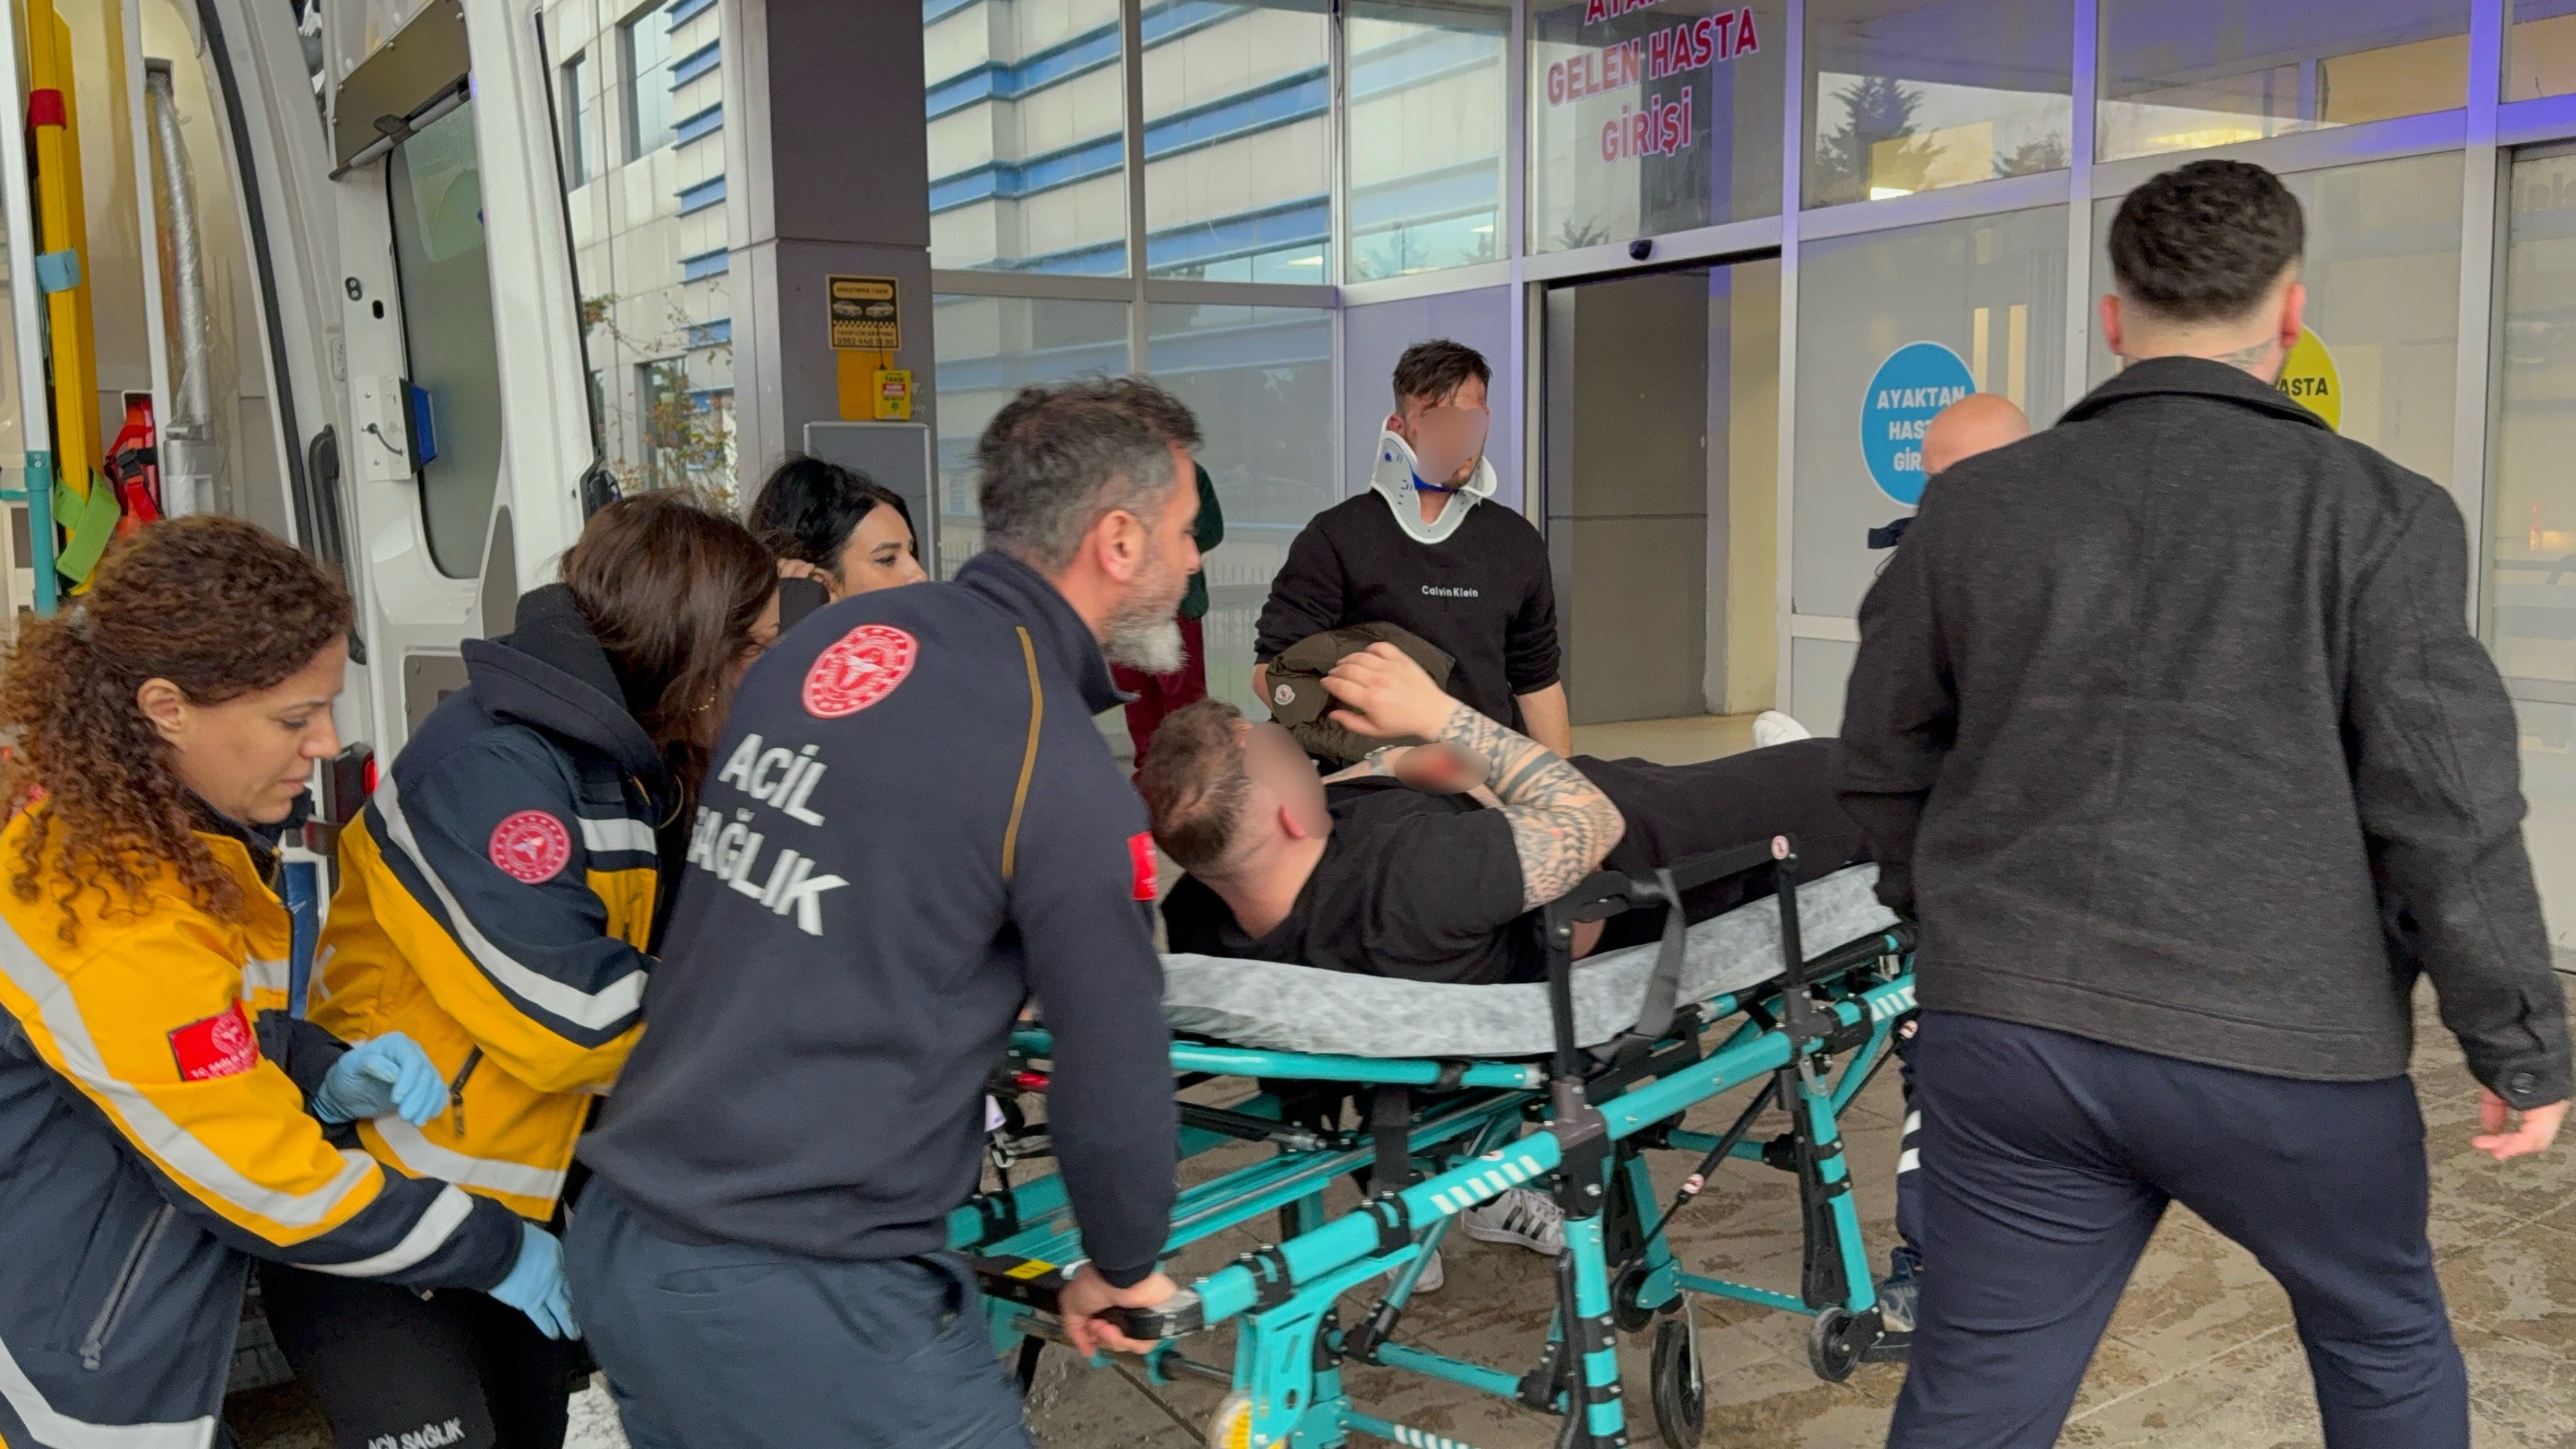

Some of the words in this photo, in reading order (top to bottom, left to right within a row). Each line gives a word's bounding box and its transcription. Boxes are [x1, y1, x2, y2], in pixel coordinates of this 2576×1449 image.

[1547, 37, 1641, 107] GELEN
[1649, 6, 1760, 80] HASTA
[1600, 86, 1693, 164] GİRİŞİ
[2280, 377, 2329, 396] ASTA
[1889, 419, 1932, 440] HAS
[1894, 446, 1922, 471] GİR
[1421, 585, 1453, 596] Calvin
[1453, 587, 1478, 597] Klein
[717, 733, 828, 827] ACİL
